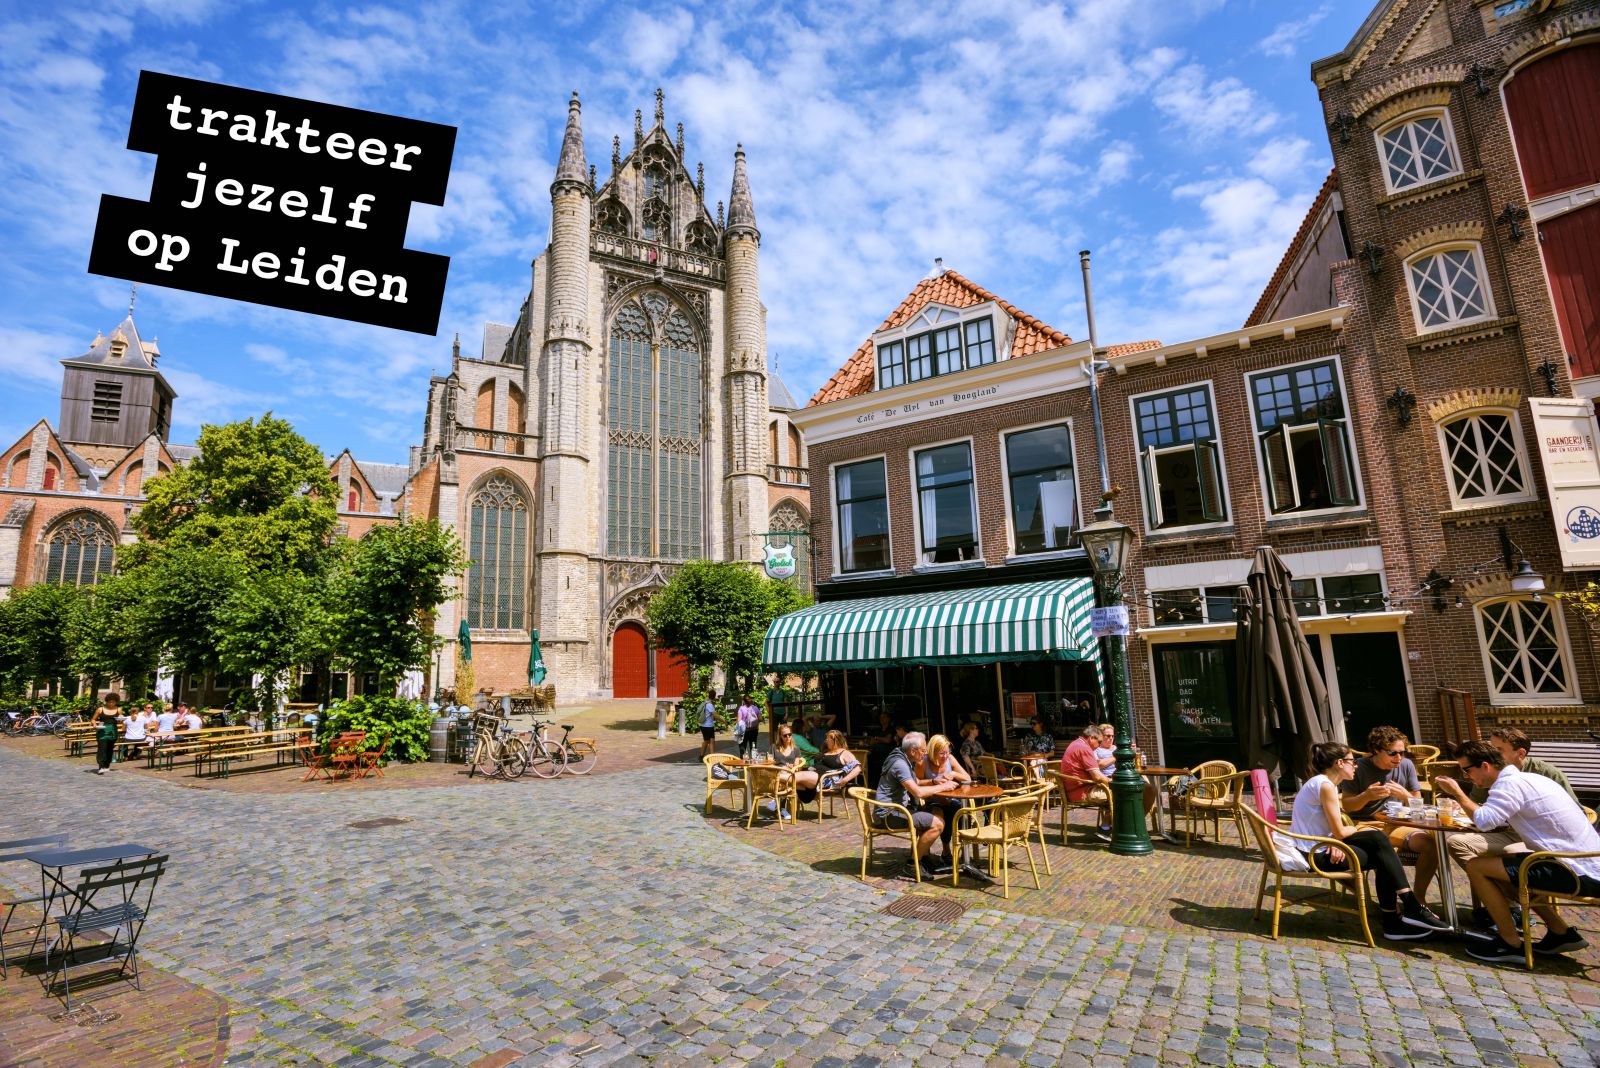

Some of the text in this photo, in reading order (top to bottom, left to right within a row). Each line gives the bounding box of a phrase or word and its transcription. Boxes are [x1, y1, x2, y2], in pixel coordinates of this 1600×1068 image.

[857, 412, 875, 423] Café
[929, 399, 945, 407] van
[1178, 678, 1198, 686] UITRIT
[1181, 707, 1204, 715] NACHT
[1198, 716, 1221, 725] LATEN
